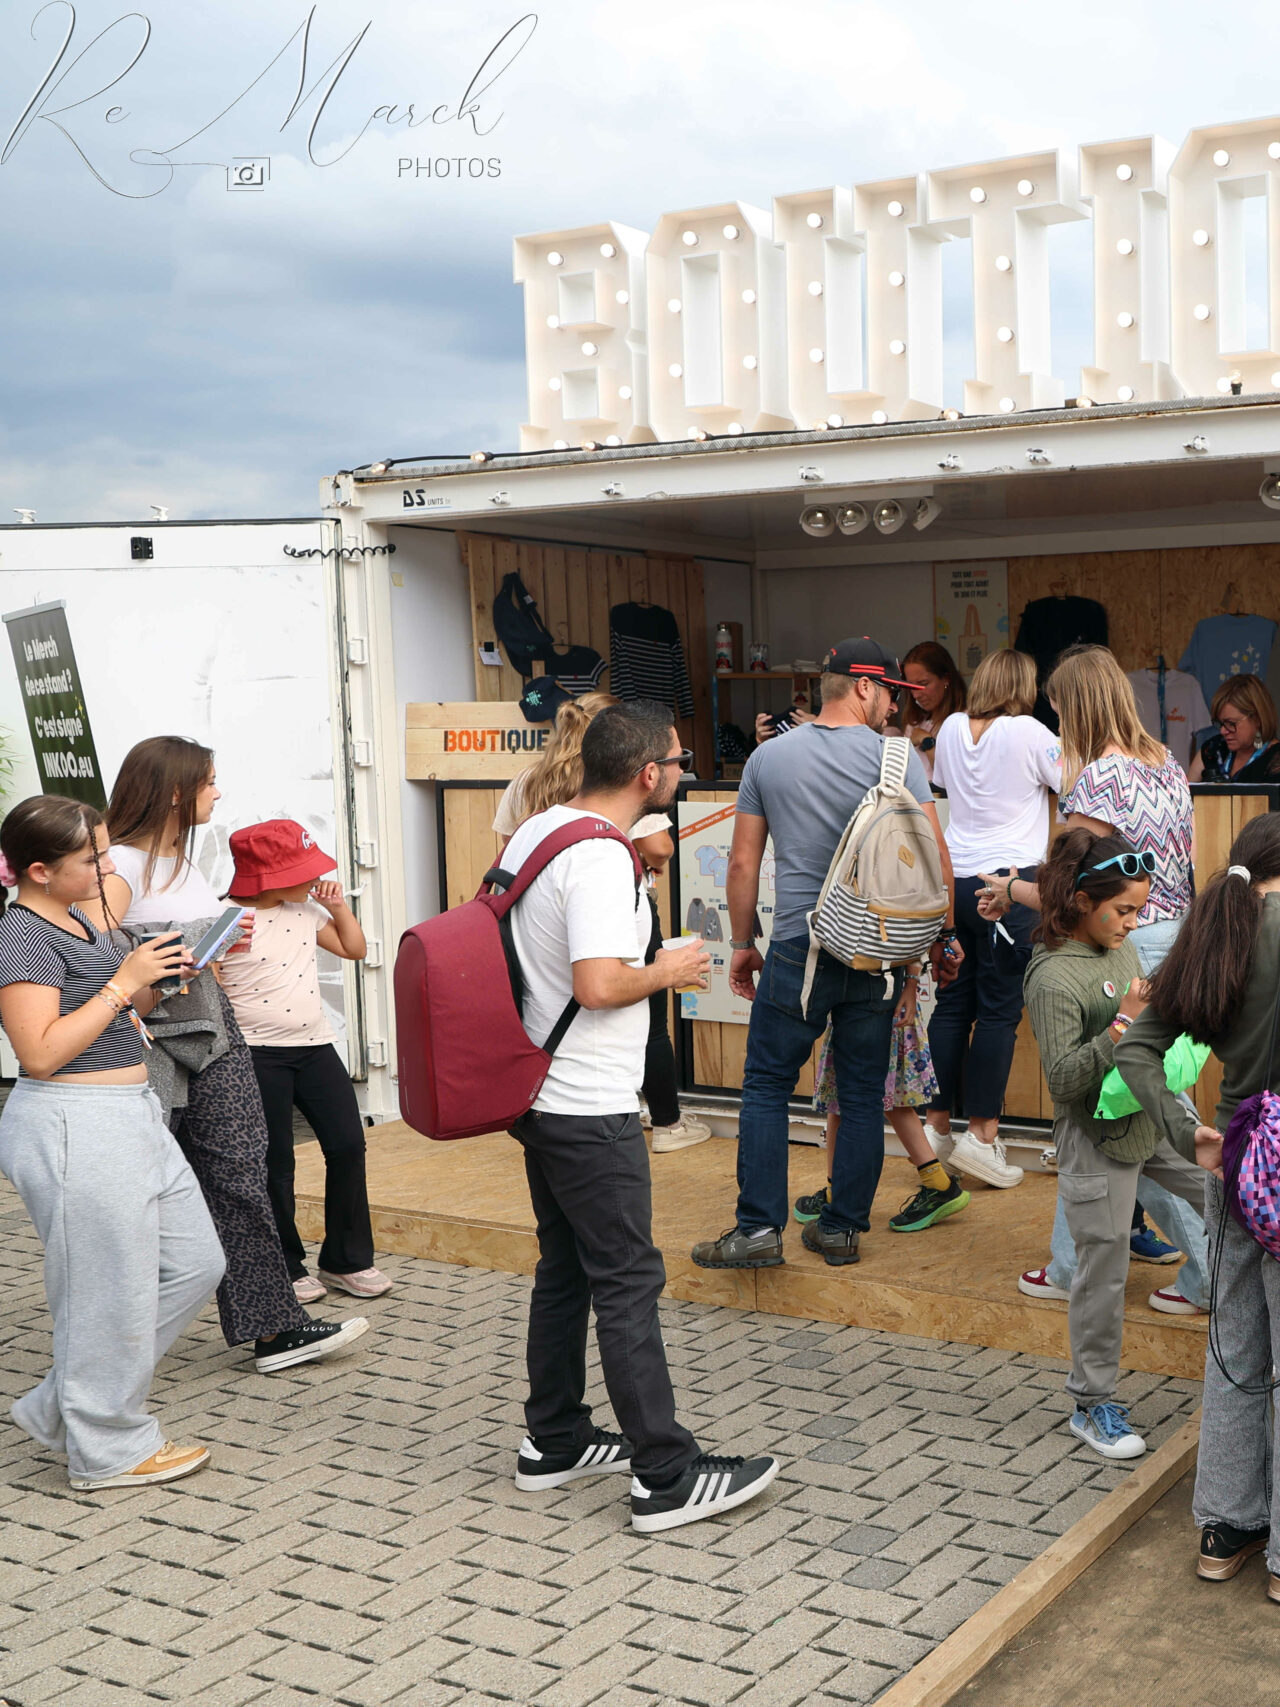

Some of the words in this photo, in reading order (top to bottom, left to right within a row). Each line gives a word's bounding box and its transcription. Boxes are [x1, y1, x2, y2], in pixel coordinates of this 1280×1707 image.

[23, 640, 34, 662] Le
[33, 635, 59, 660] Merch
[25, 675, 35, 697] de
[35, 677, 45, 696] ce
[44, 669, 68, 695] stand
[34, 715, 58, 739] C'est
[58, 710, 84, 745] signé
[444, 729, 550, 754] BOUTIQUE
[42, 750, 95, 779] INKOO.eu
